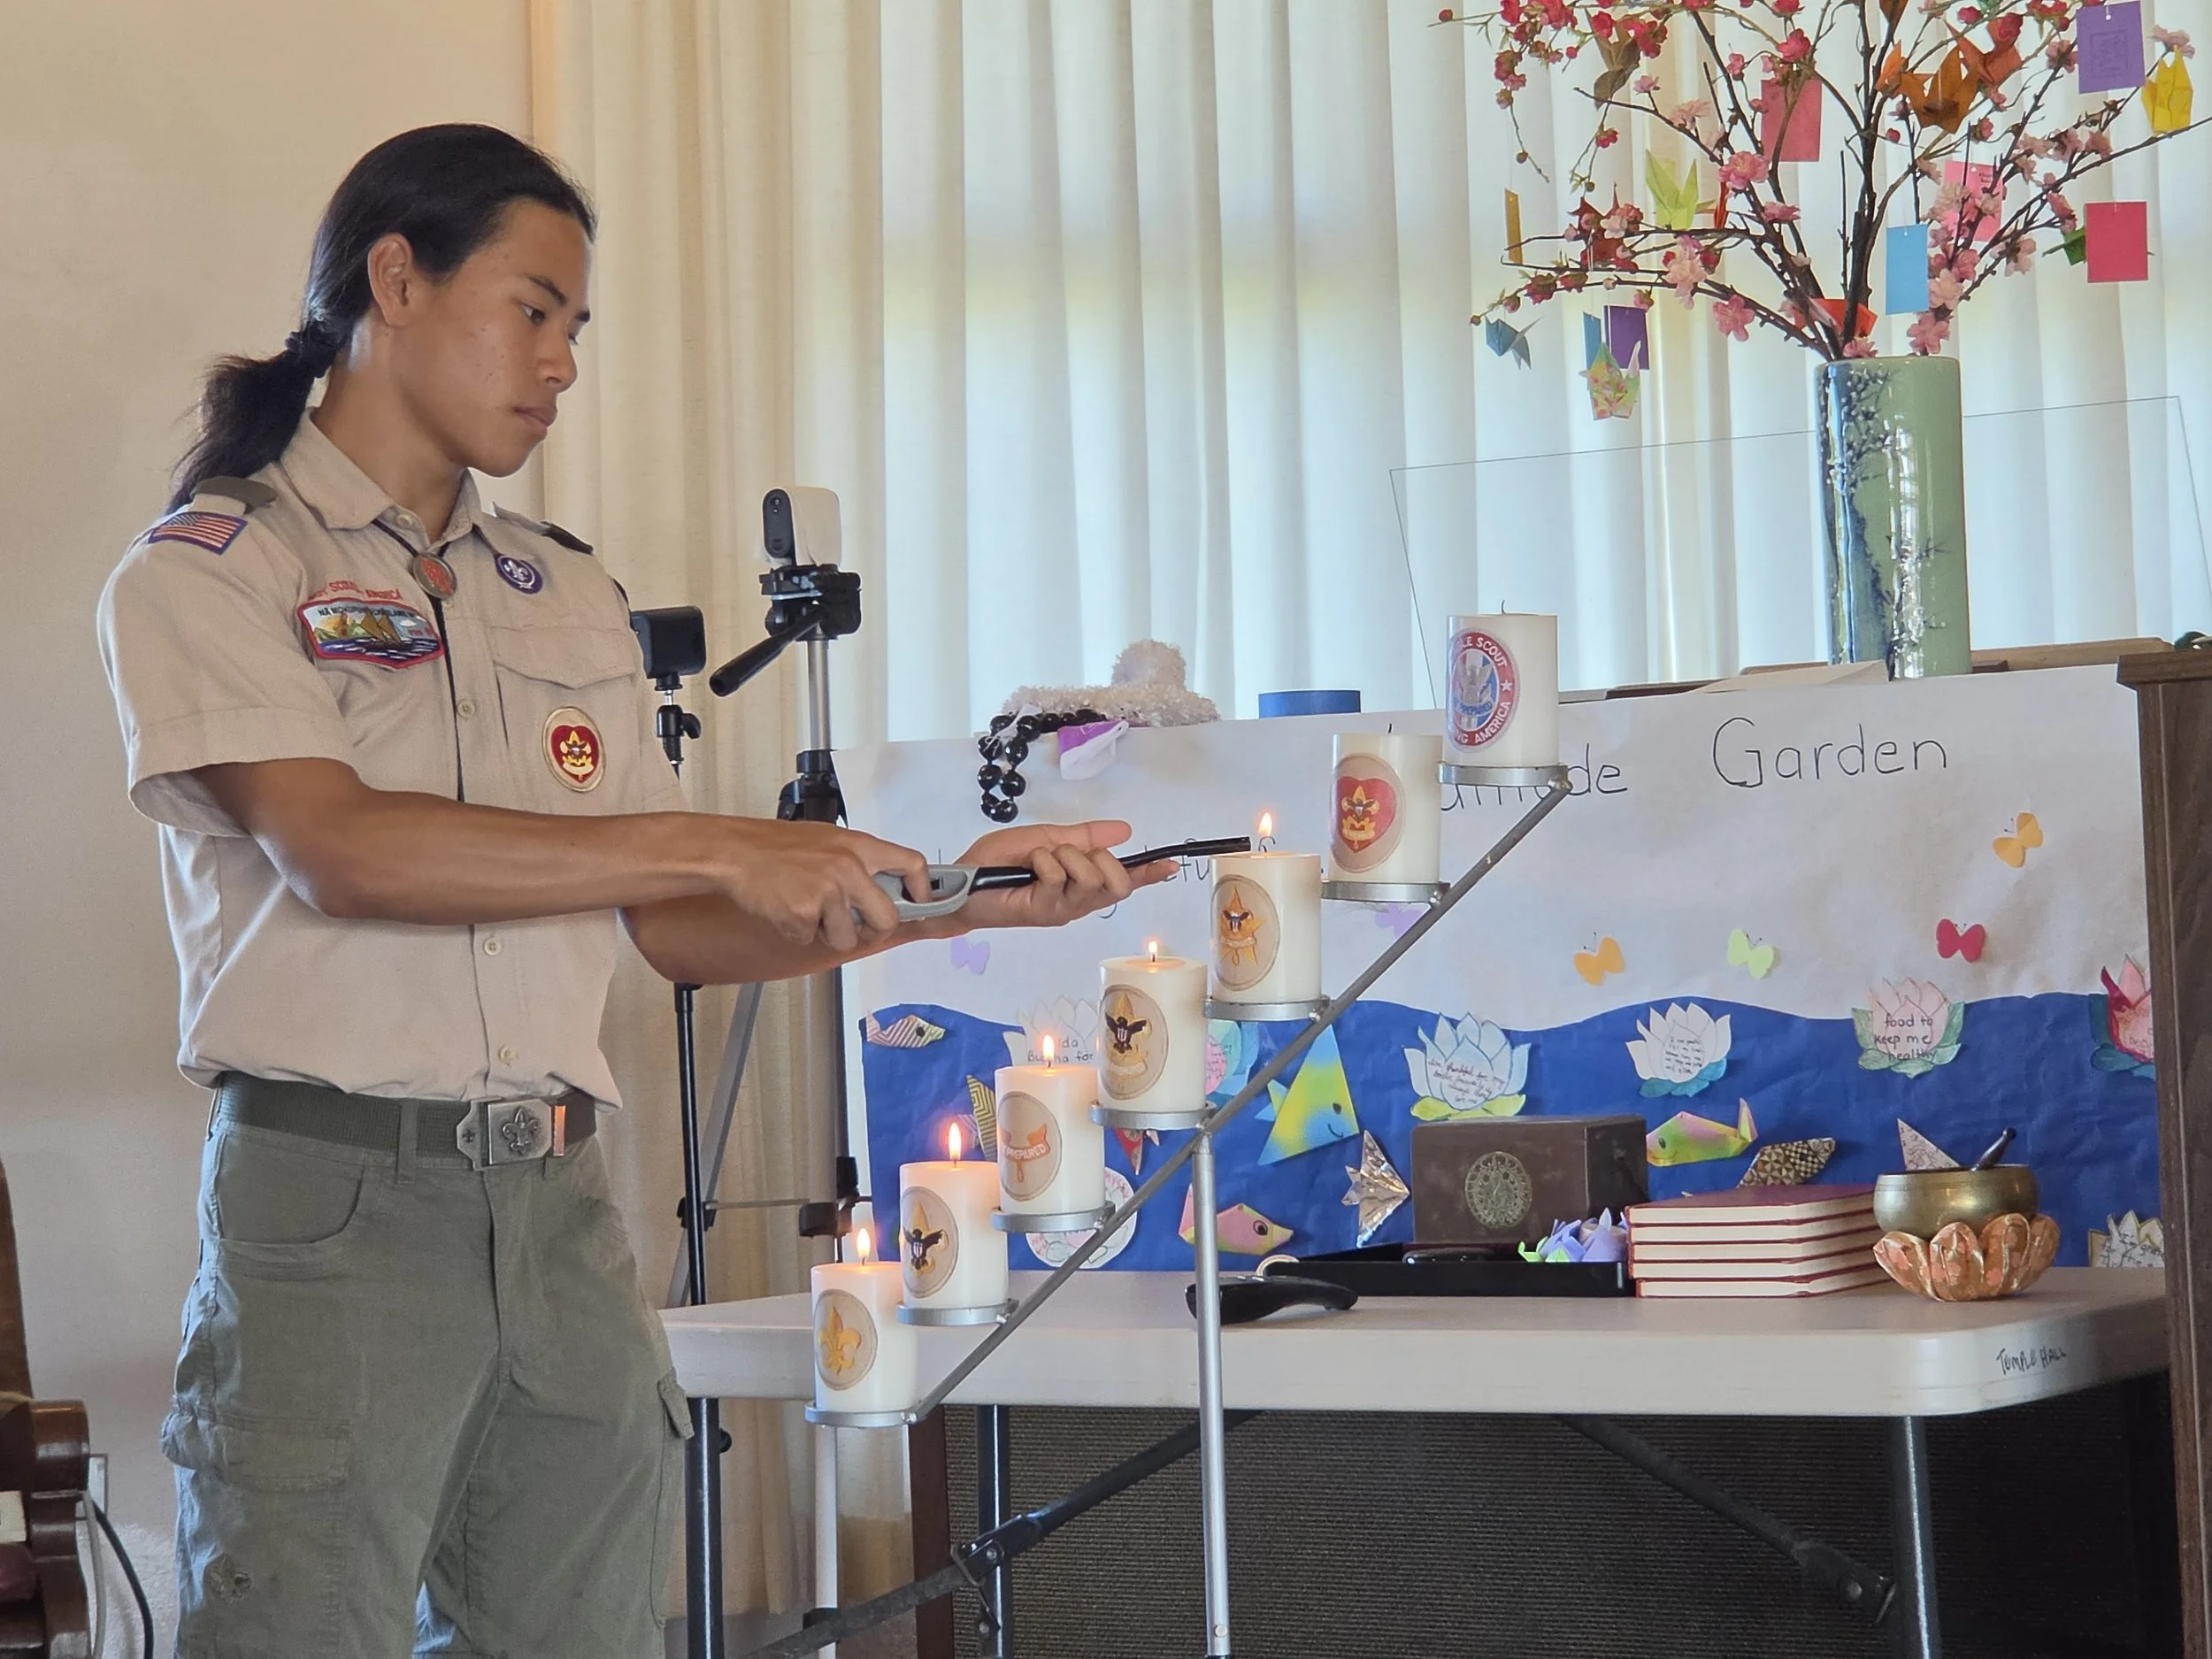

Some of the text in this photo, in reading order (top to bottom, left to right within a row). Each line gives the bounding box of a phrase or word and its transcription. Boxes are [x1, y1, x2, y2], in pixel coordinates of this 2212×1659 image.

[1476, 637, 1508, 666] SCOUT
[1474, 702, 1511, 744] AMERICA
[1713, 717, 1947, 788] Garden
[1885, 1012, 1934, 1027] food to
[1075, 1051, 1094, 1062] for
[1887, 1048, 1938, 1063] healthy
